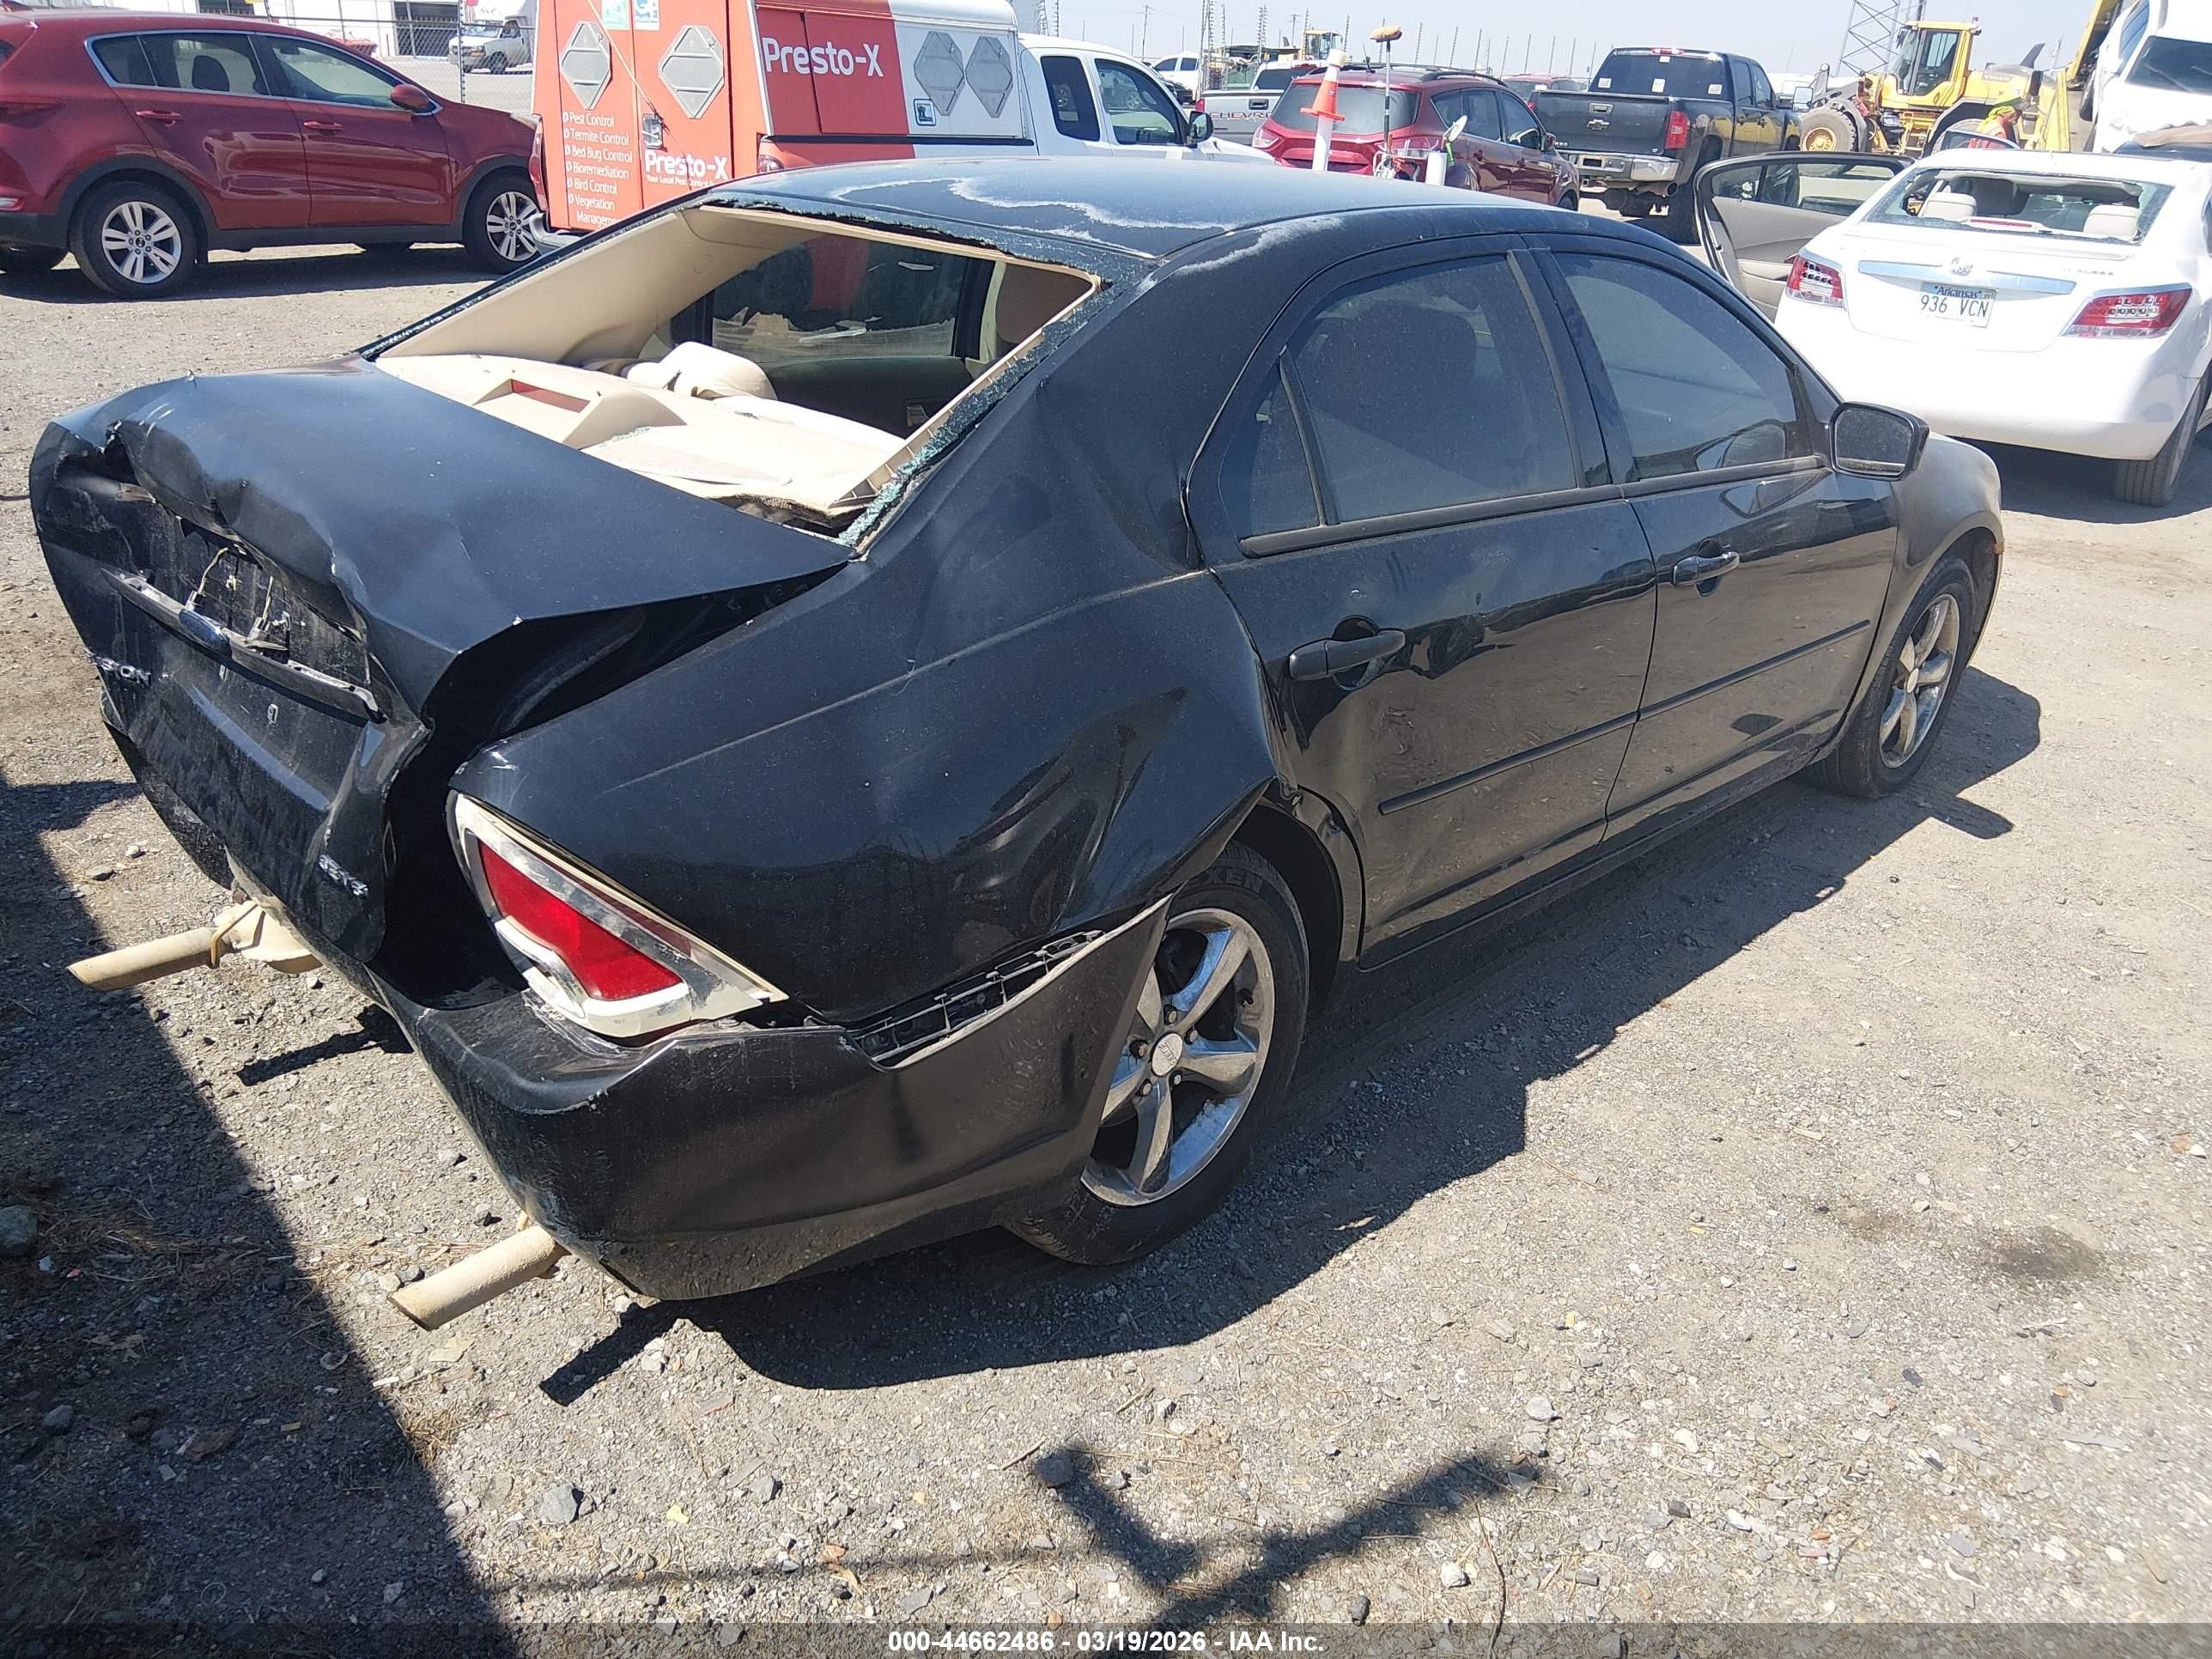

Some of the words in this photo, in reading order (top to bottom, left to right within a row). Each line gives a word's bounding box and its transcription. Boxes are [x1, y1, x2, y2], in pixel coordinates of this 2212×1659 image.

[762, 37, 884, 77] Presto-X
[569, 112, 585, 125] Pest
[586, 112, 614, 127] Control
[571, 128, 599, 143] Termite
[599, 131, 629, 145] Control
[572, 144, 586, 158] Bed
[588, 146, 601, 162] Bug
[603, 148, 632, 163] Control
[573, 161, 629, 179] Bioremediation
[645, 149, 728, 179] Presto-X
[574, 178, 588, 191] Bird
[589, 179, 617, 195] Control
[574, 193, 615, 210] Vegetation
[1936, 285, 1978, 300] Arkansas
[1920, 295, 1948, 313] 936
[1960, 298, 1990, 318] VCN
